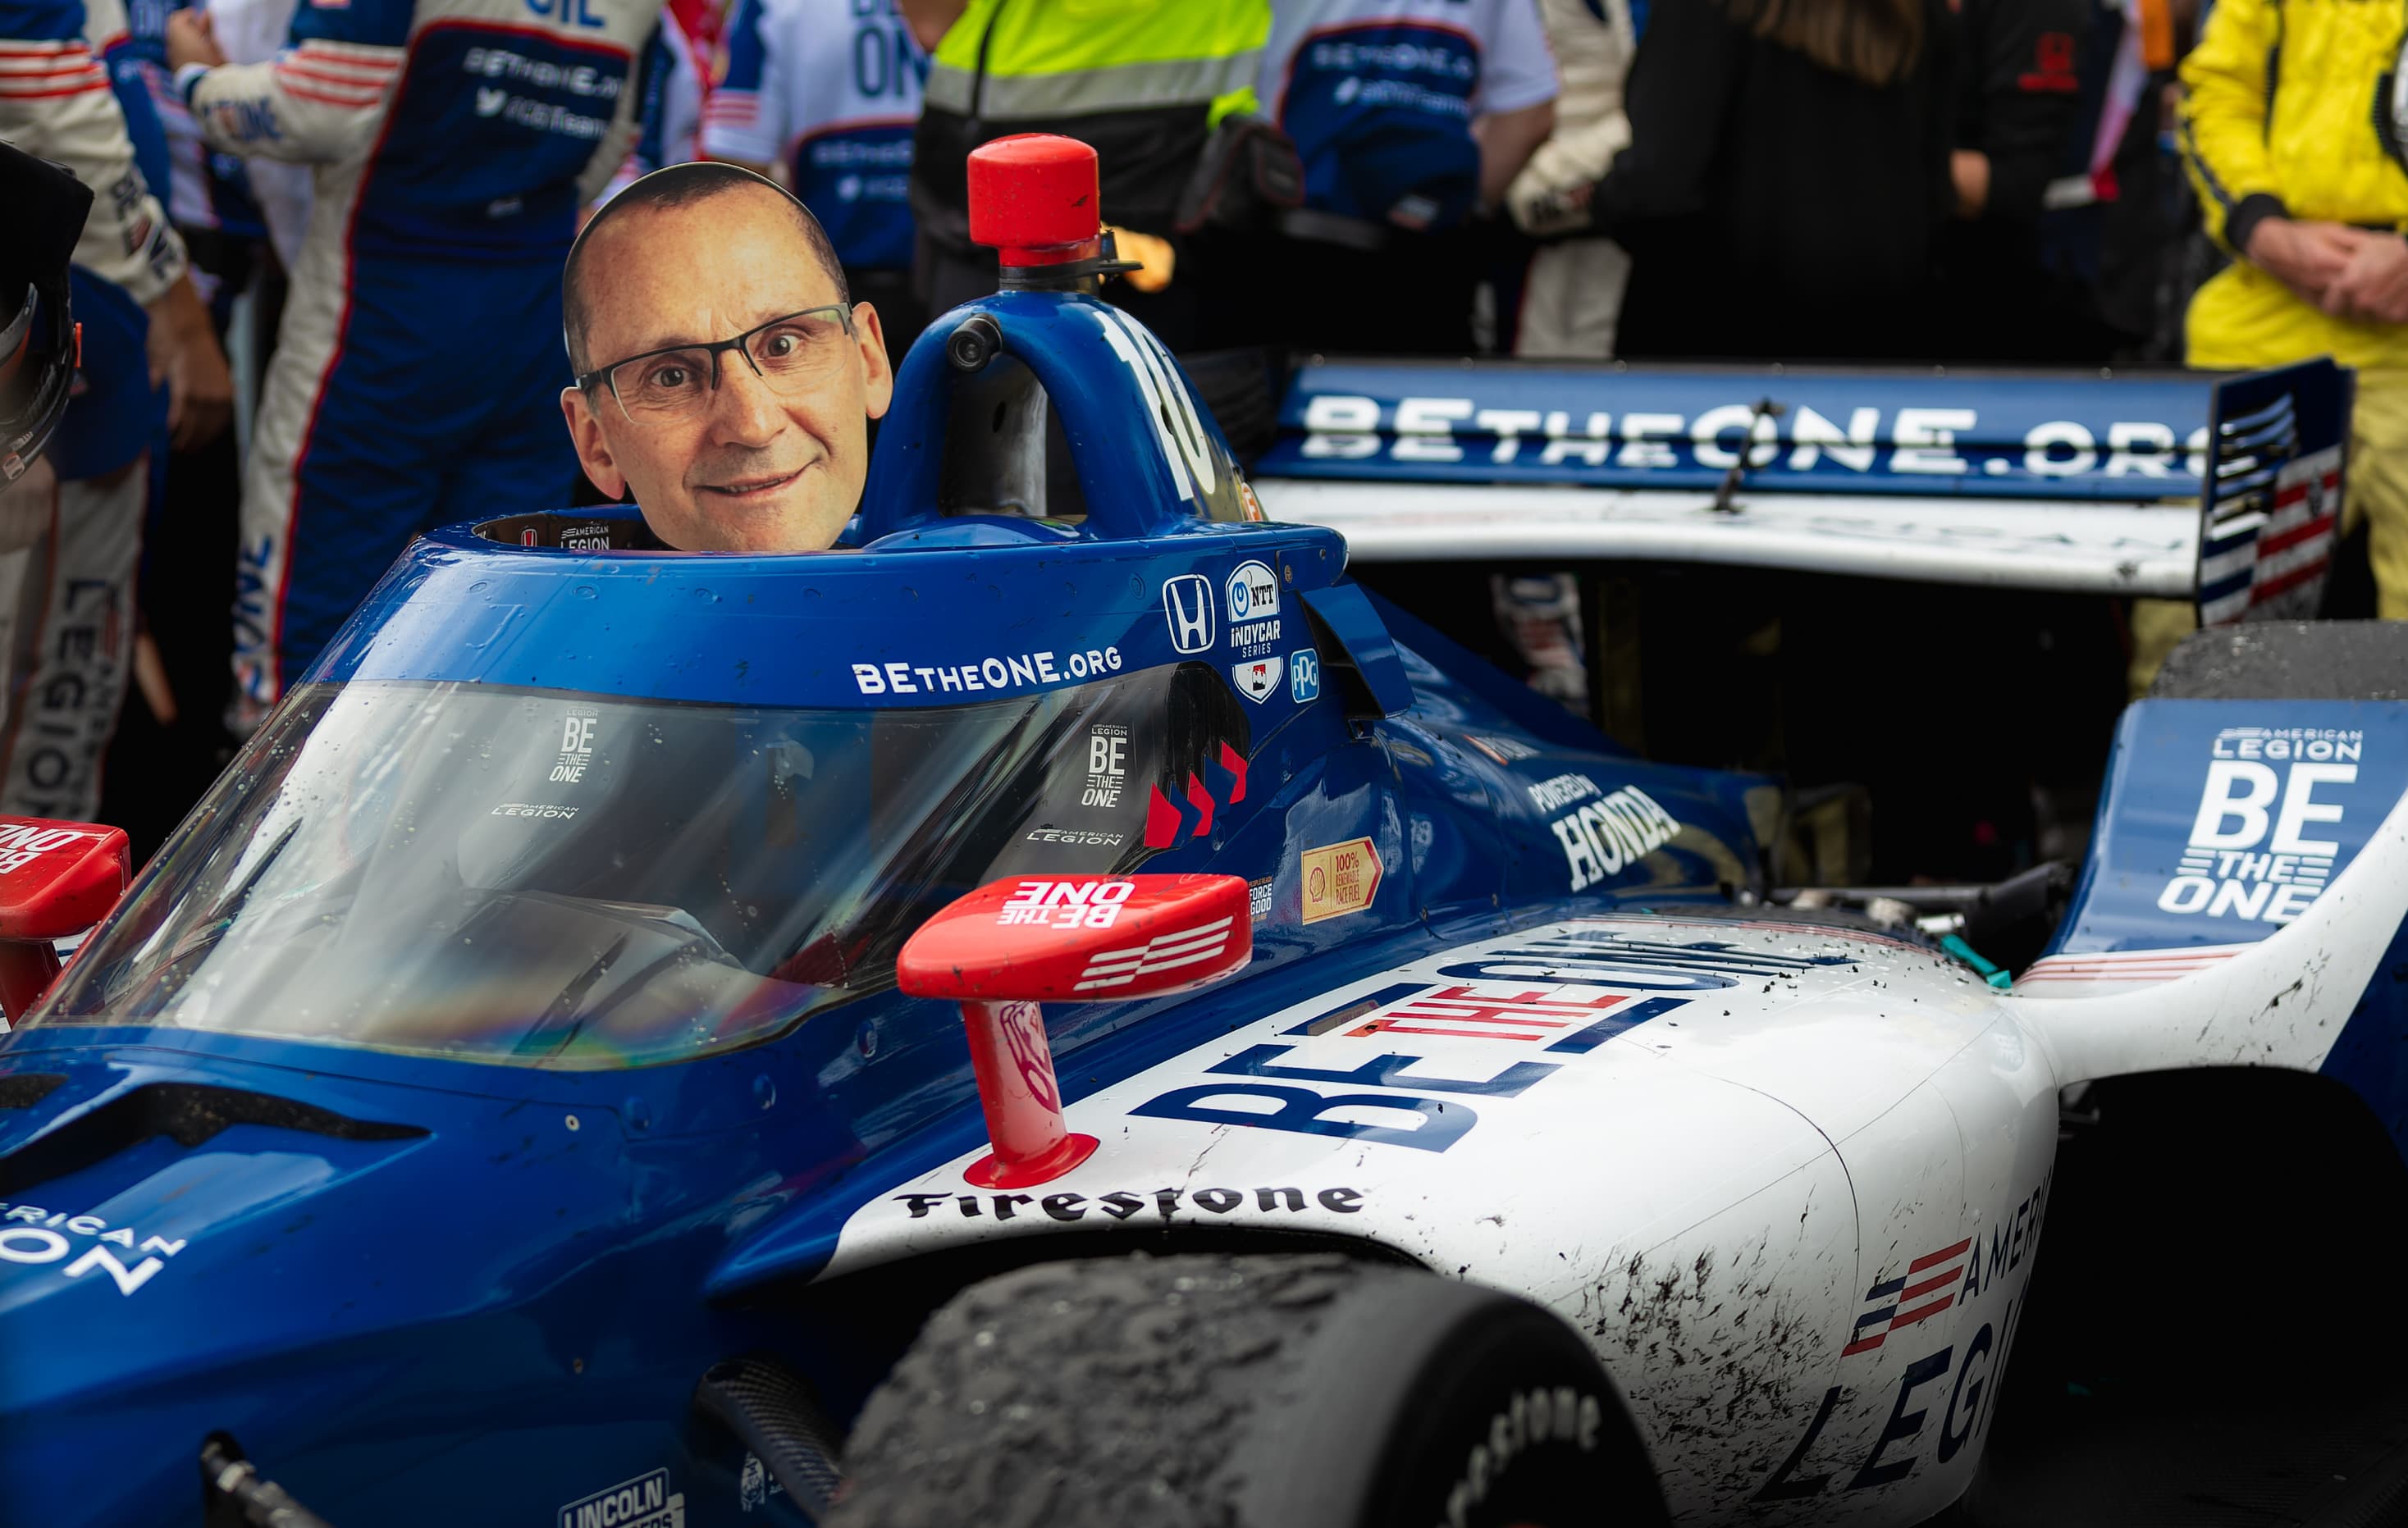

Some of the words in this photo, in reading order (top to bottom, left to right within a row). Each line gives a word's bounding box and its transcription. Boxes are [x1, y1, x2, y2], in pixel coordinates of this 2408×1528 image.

[1092, 307, 1216, 502] 10
[575, 525, 609, 536] AMERICAN
[1250, 584, 1274, 608] NTT
[1231, 619, 1281, 648] INDYCAR
[1242, 642, 1271, 658] SERIES
[852, 646, 1122, 695] BETHEONE.ORG
[1292, 655, 1318, 696] PPG
[561, 716, 598, 754] BE
[1091, 728, 1127, 736] LEGION
[2260, 728, 2364, 741] AMERICAN
[1088, 735, 1128, 776] BE
[2212, 739, 2363, 761] LEGION
[548, 764, 587, 783] ONE
[1096, 774, 1117, 789] THE
[523, 804, 579, 812] AMERICAN
[1081, 788, 1122, 808] ONE
[2188, 759, 2359, 857] BE
[491, 807, 576, 820] LEGION
[1026, 832, 1122, 846] LEGION
[1061, 829, 1124, 839] AMERICAN
[1551, 784, 1682, 893] HONDA
[1336, 851, 1359, 873] 100%
[2216, 851, 2296, 884] THE
[1005, 882, 1136, 905] ONE
[1249, 883, 1273, 901] FORCE
[2157, 875, 2324, 925] ONE
[996, 908, 1050, 925] THE
[1051, 903, 1123, 928] BE
[1250, 896, 1272, 915] GOOD
[1436, 929, 1866, 992] ONE
[1344, 986, 1632, 1042] THE
[1126, 1043, 1565, 1153] BE
[892, 1186, 1364, 1222] Firestone
[0, 1202, 188, 1257] RICAN
[1748, 1274, 2030, 1503] LEGI
